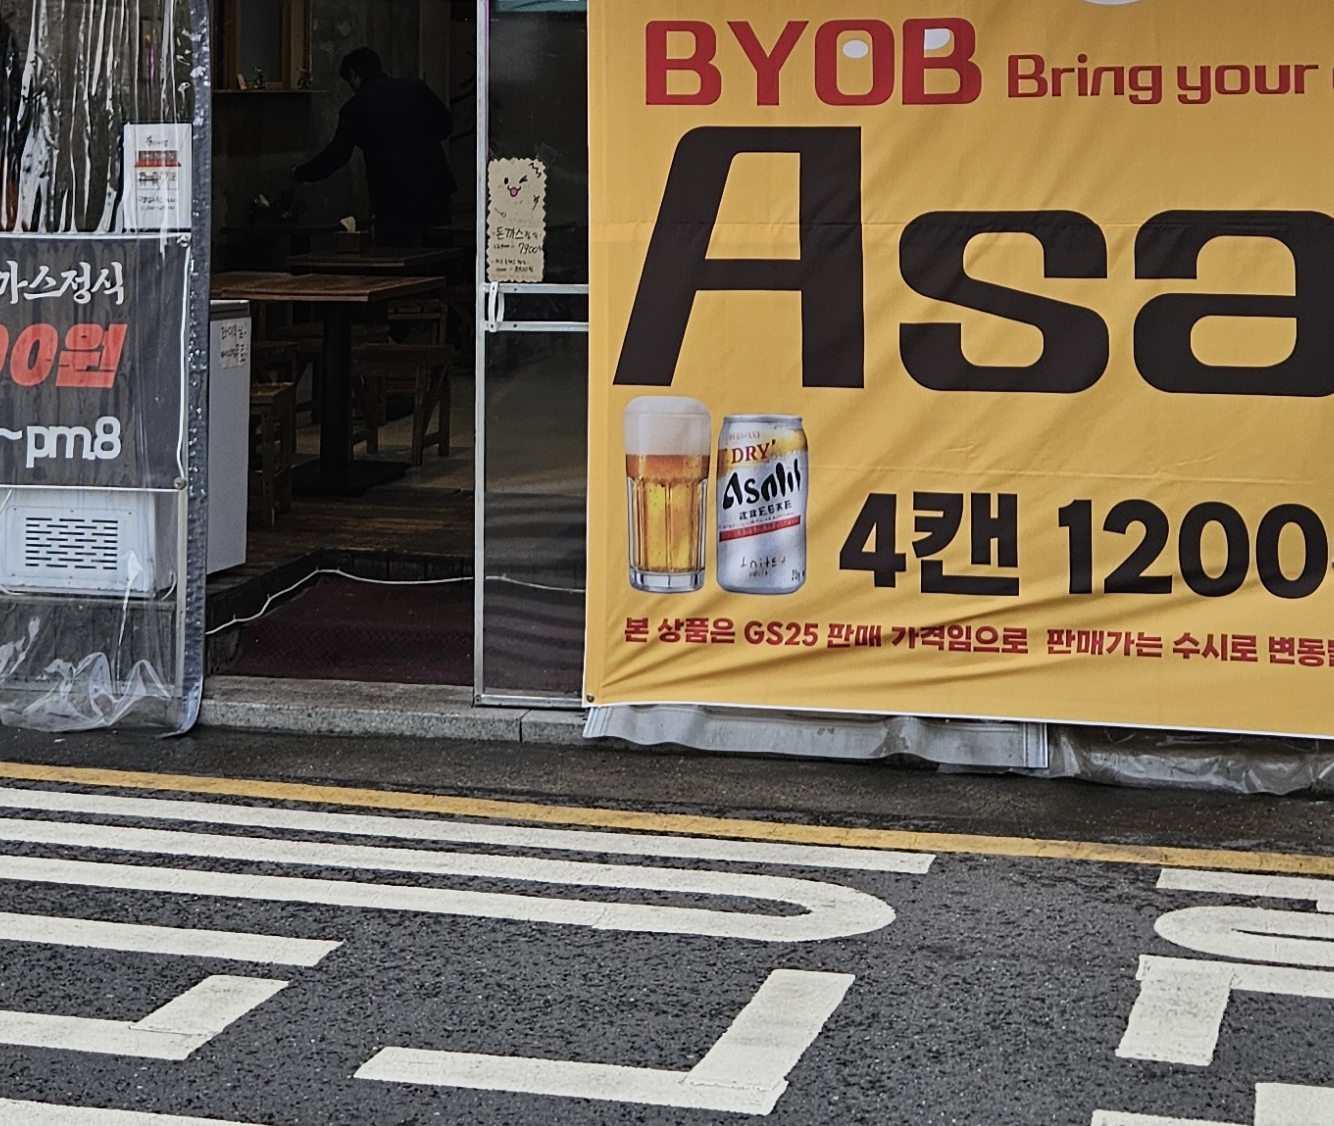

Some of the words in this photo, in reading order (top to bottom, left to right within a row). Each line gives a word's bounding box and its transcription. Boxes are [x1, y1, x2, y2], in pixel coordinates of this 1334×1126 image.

[645, 17, 983, 107] BYOB
[1007, 53, 1162, 105] Bring
[1177, 64, 1320, 105] your
[722, 458, 802, 510] Asahi
[839, 491, 1020, 597] 4캔
[624, 617, 649, 643] 본
[656, 616, 736, 646] 상품은
[743, 620, 819, 648] GS25
[826, 622, 883, 651] 판매
[890, 623, 1030, 656] 가격임으로
[1046, 628, 1164, 659] 판매가는
[1172, 632, 1258, 665] 수시로
